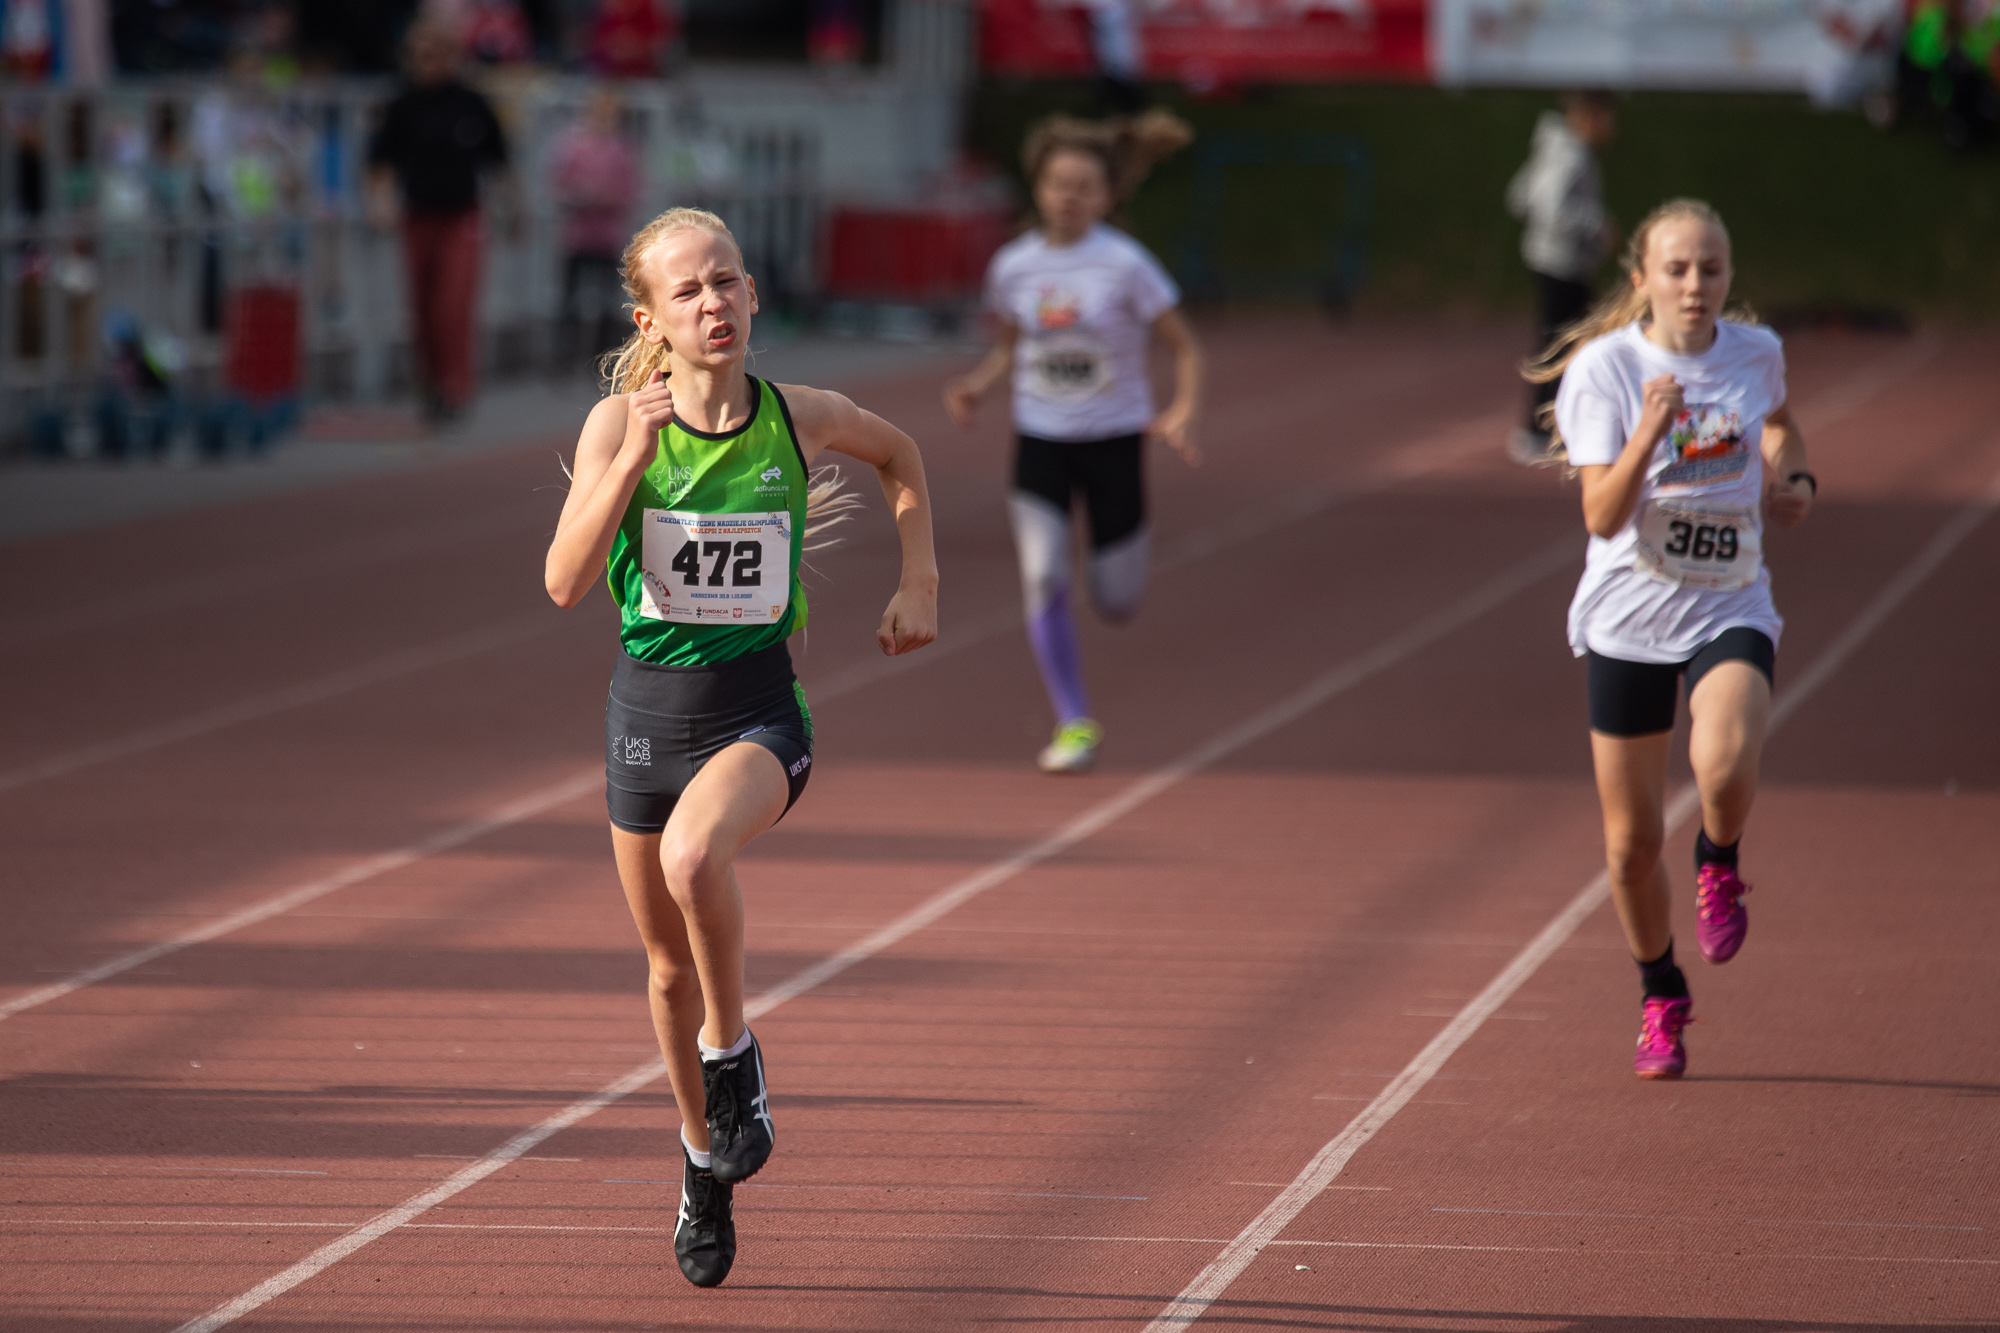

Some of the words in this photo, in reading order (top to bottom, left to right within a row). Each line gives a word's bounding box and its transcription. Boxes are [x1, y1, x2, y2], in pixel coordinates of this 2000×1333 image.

[668, 466, 692, 480] UKS
[656, 516, 715, 527] LEKKOATLETYCZNE
[747, 518, 783, 527] OLIMPIJSKIE
[1664, 521, 1739, 562] 369
[671, 540, 762, 587] 472
[625, 736, 651, 750] UKS
[625, 748, 651, 761] DAB
[789, 761, 802, 777] UKS
[800, 755, 811, 769] DA
